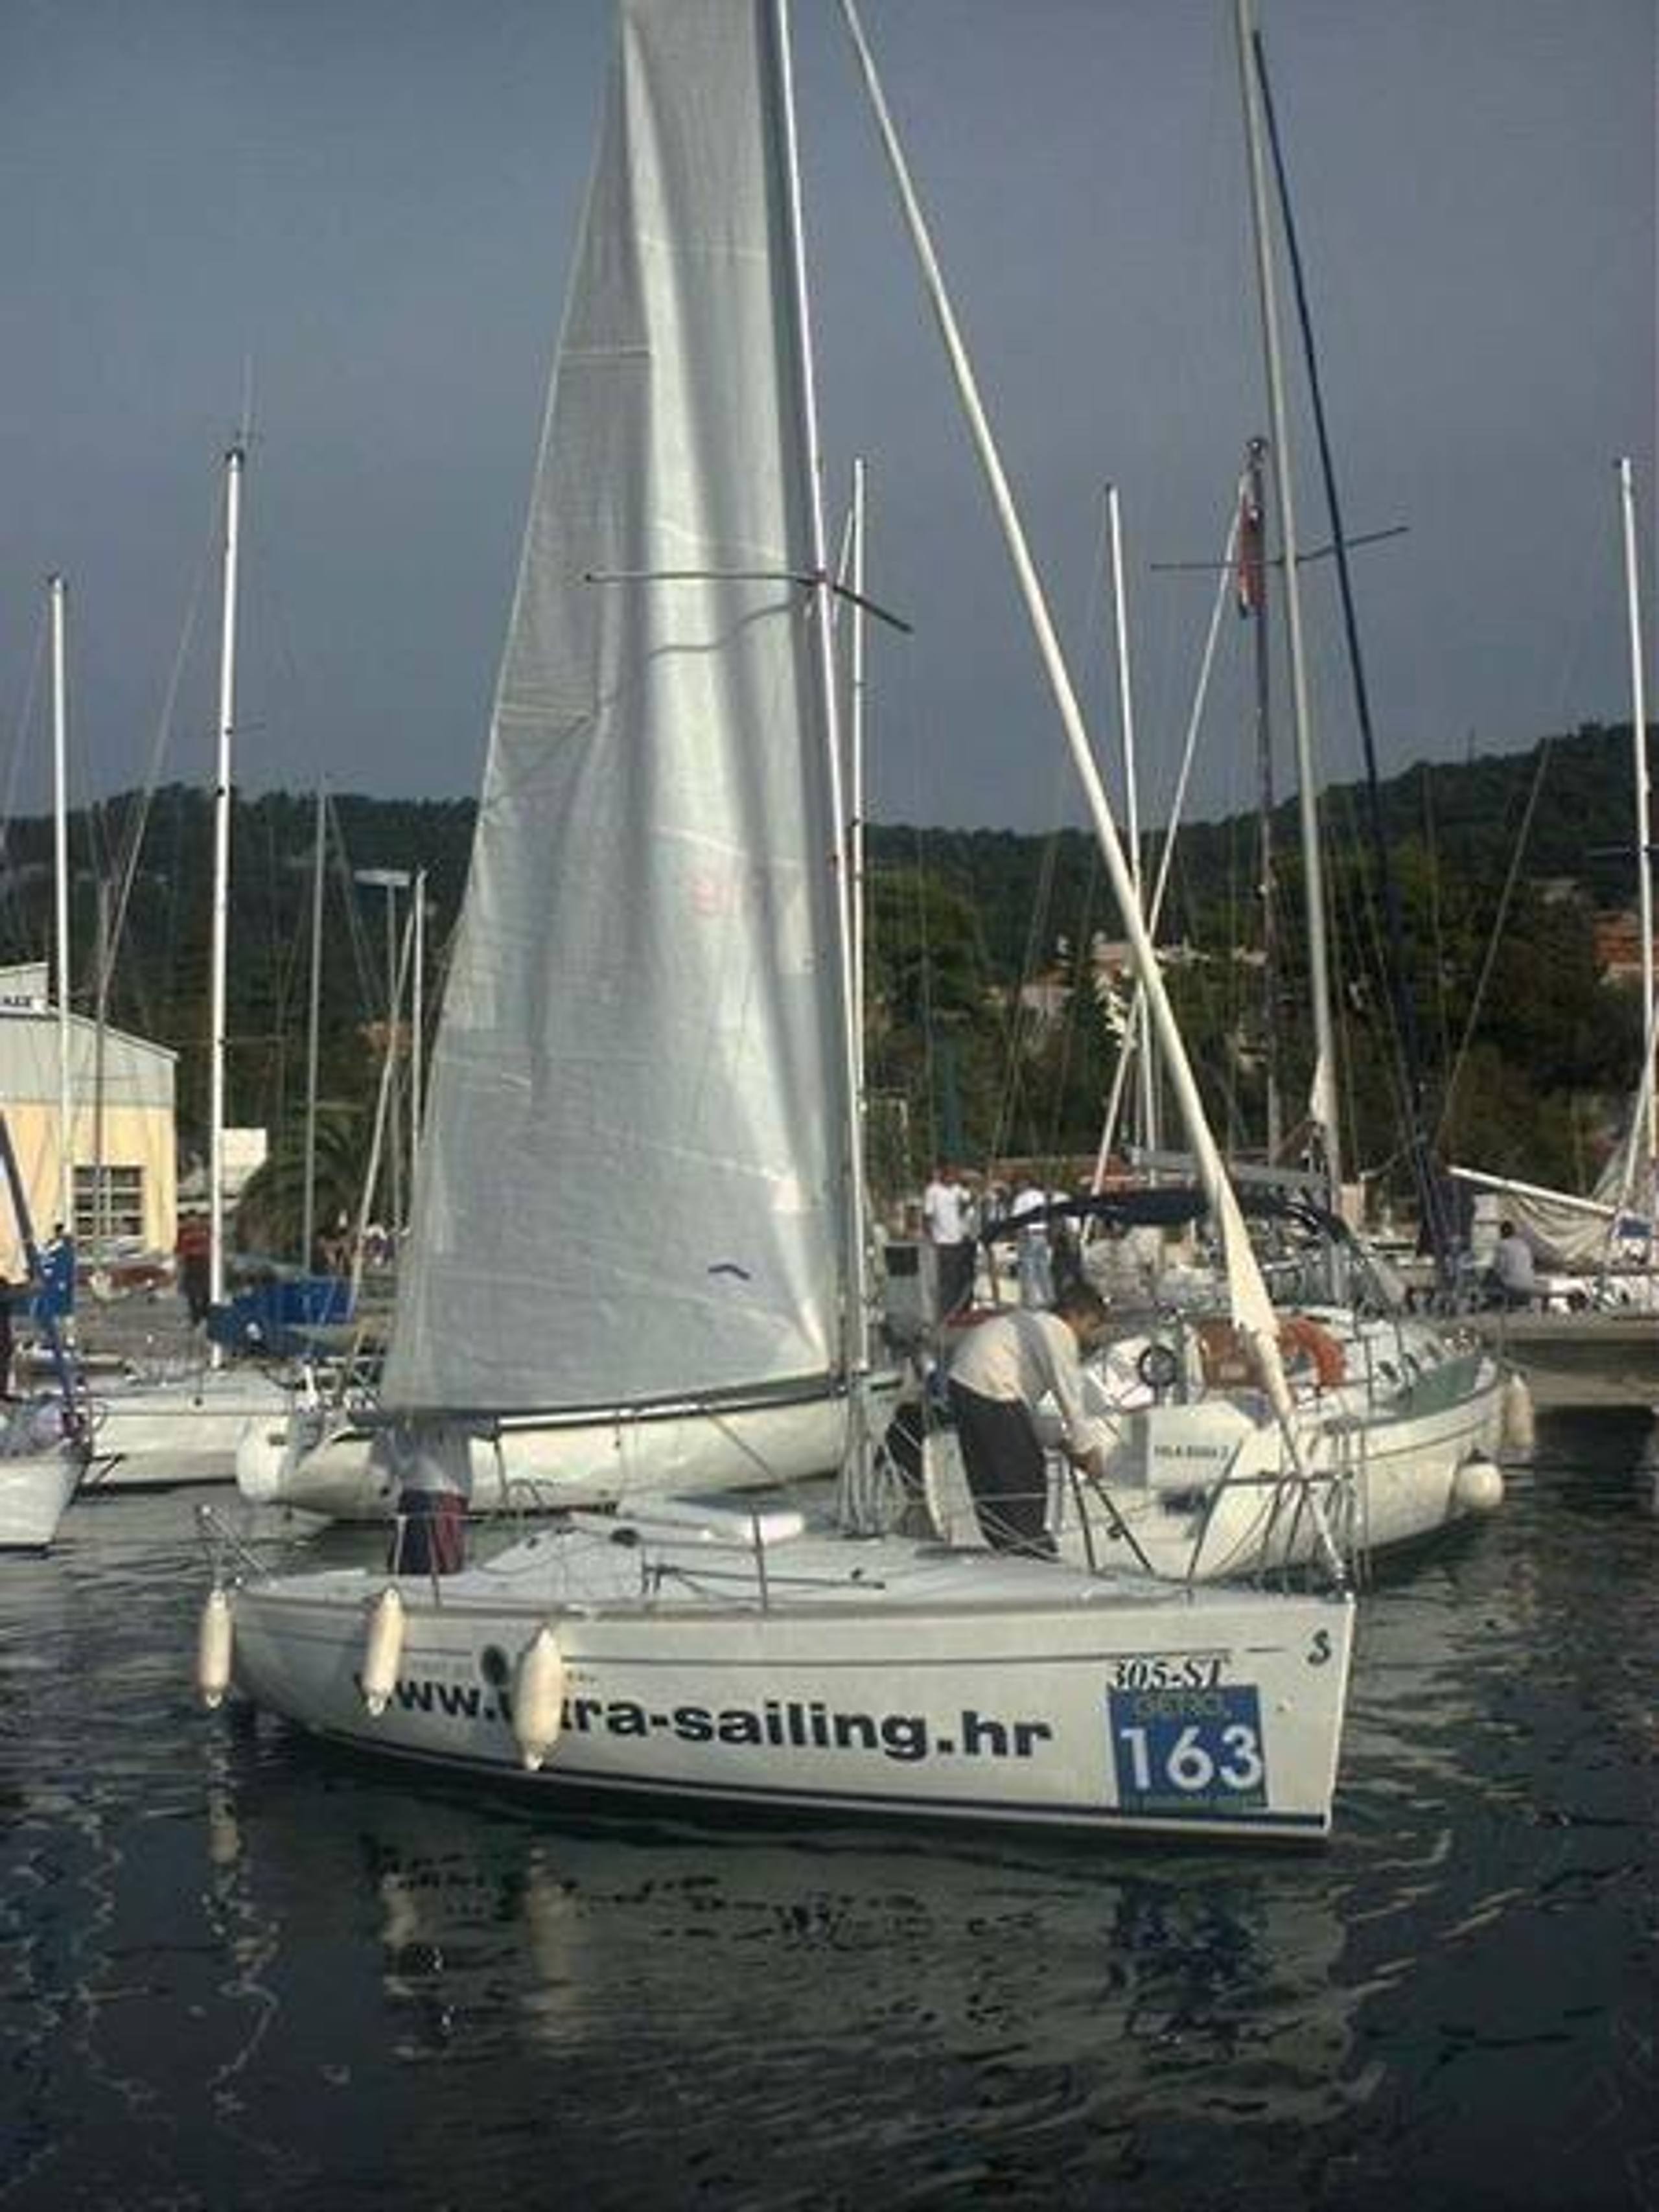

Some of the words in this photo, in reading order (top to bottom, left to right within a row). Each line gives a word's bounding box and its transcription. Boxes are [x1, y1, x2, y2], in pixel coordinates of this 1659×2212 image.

[1109, 1657, 1229, 1690] 305-ST
[354, 1672, 1052, 1760] ww.ra-sailing.hr
[1119, 1725, 1263, 1791] 163
